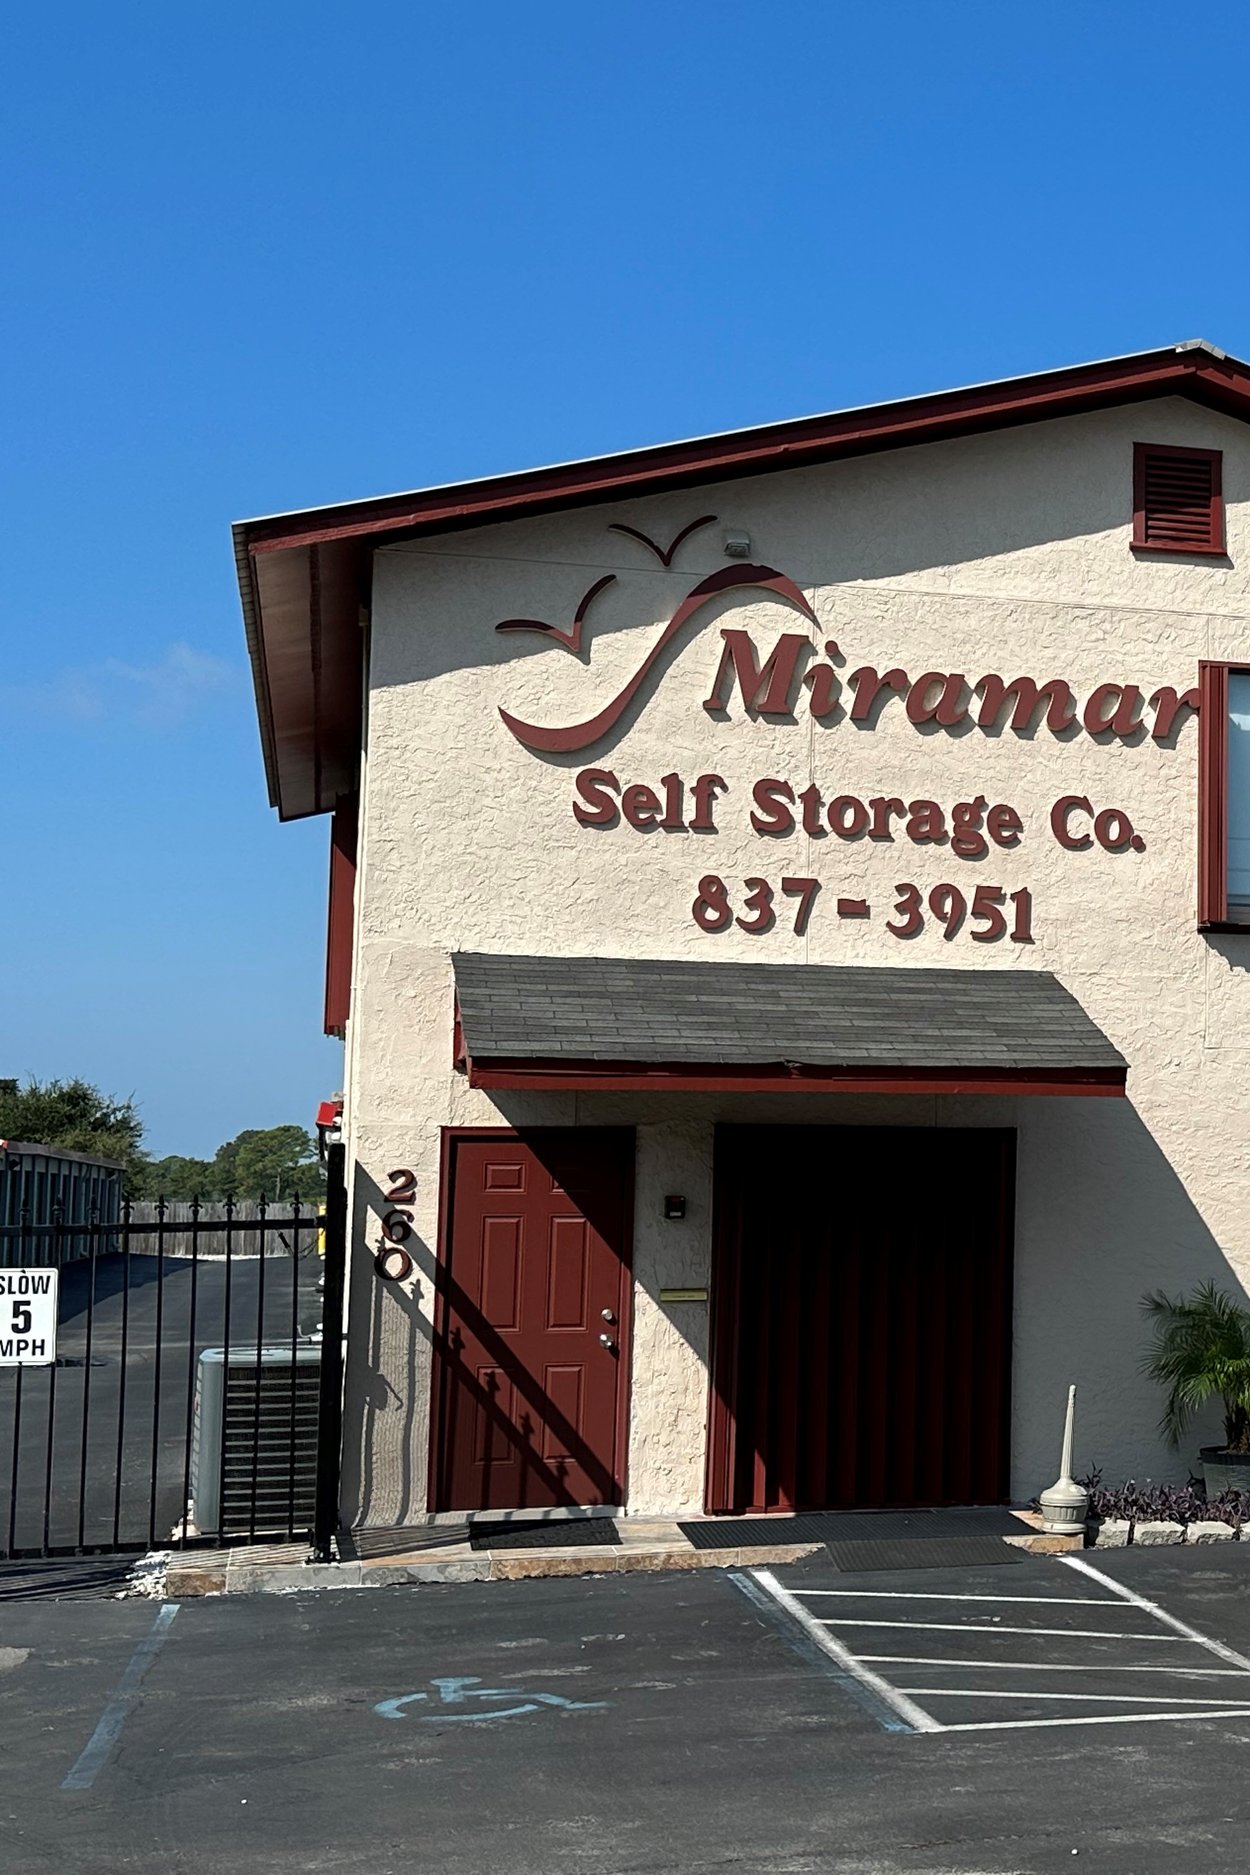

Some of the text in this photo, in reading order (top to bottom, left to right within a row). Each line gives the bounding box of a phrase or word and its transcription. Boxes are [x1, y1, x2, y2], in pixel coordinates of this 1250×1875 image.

[703, 628, 1200, 738] Miramar
[573, 768, 1146, 856] Self Storage Co.
[11, 1300, 32, 1334] 5
[0, 1339, 45, 1357] MPH
